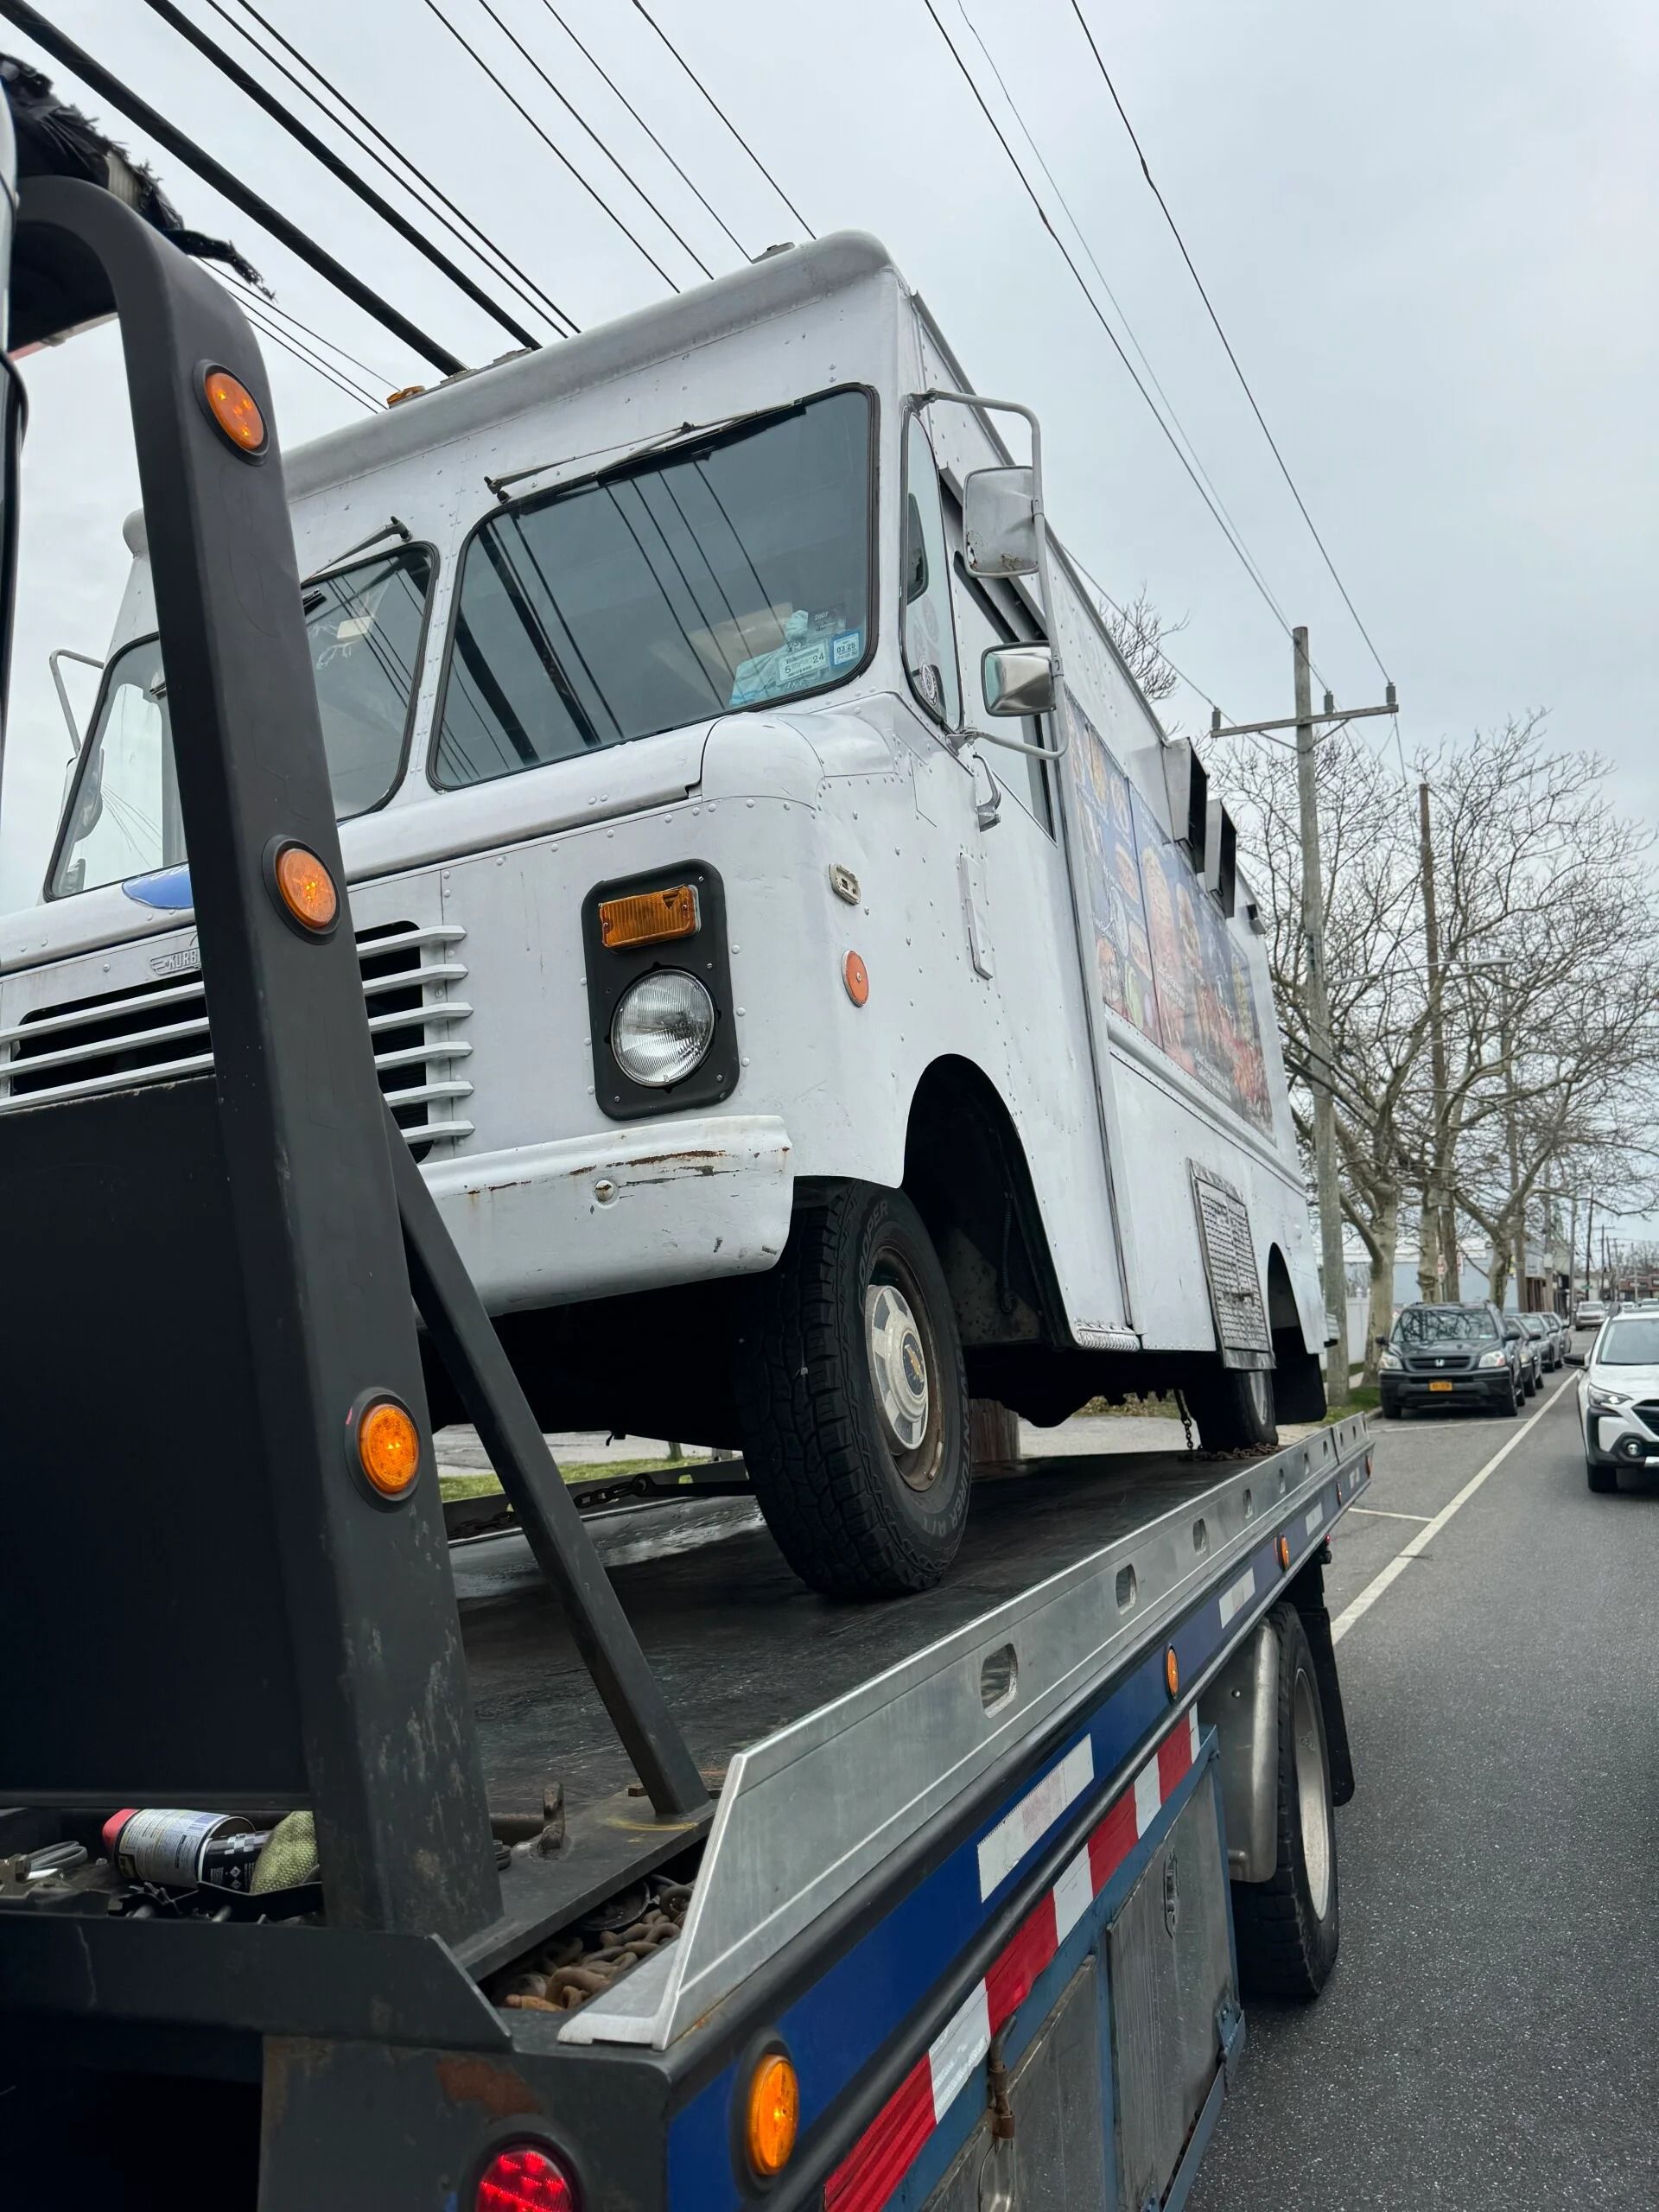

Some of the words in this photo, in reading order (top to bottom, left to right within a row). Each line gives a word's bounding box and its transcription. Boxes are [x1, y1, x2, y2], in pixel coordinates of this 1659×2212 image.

[785, 665, 791, 674] 5
[813, 653, 824, 663] 24
[858, 1199, 888, 1316] COOPER
